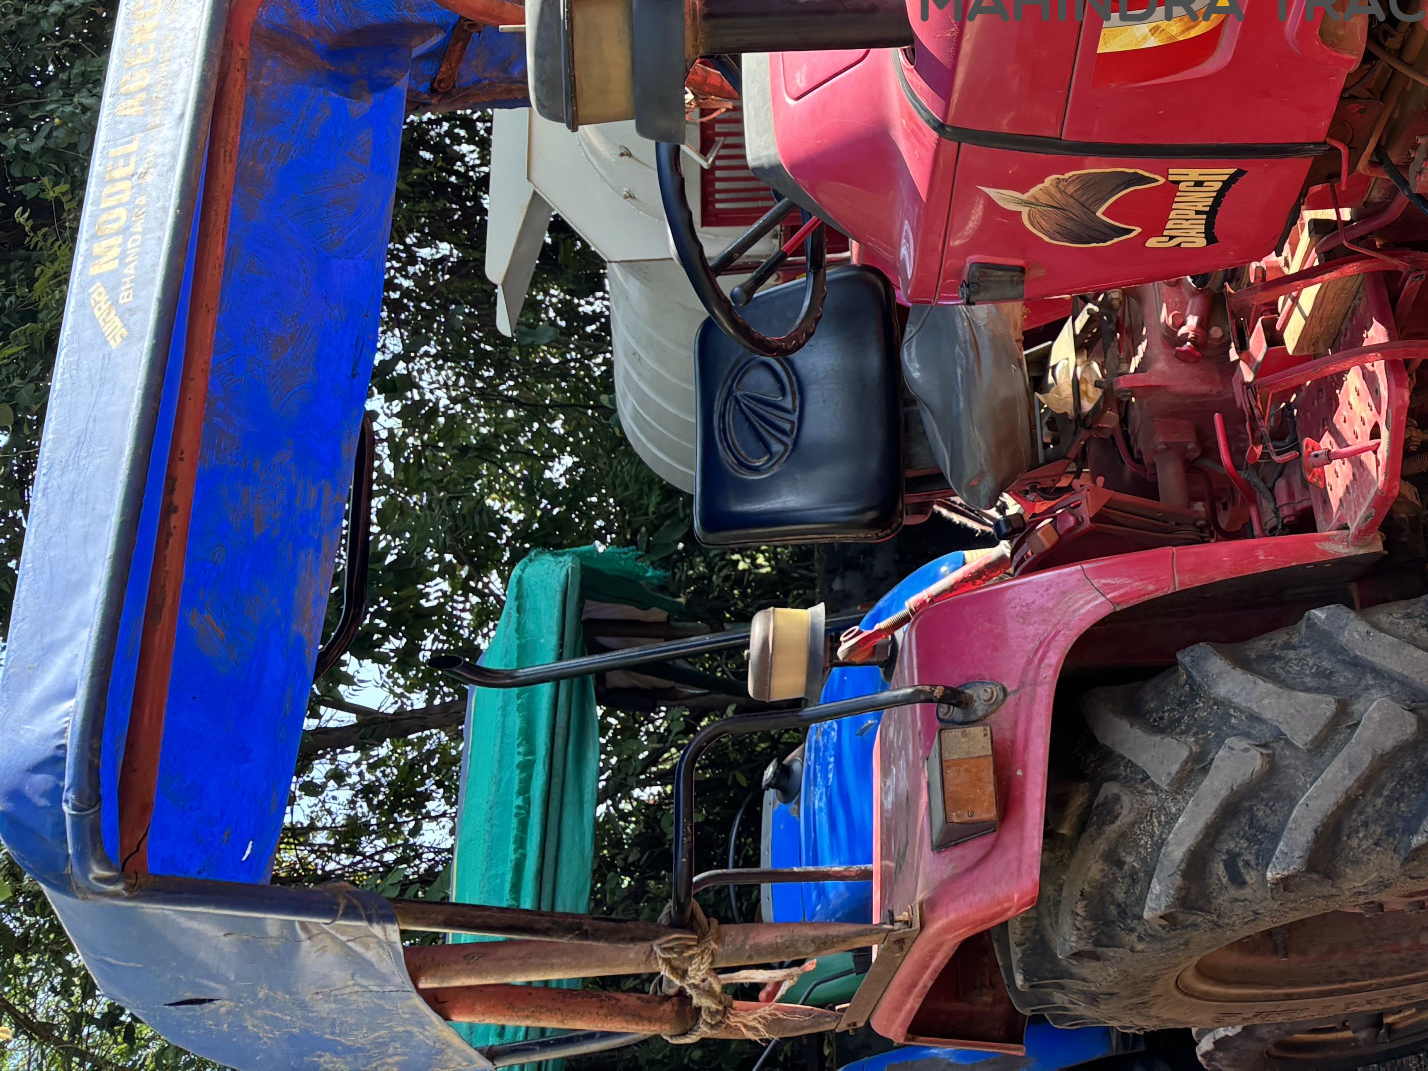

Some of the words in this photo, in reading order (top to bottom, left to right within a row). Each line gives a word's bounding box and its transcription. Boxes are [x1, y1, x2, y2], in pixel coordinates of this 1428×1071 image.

[88, 135, 141, 276] MODEL
[118, 195, 147, 304] BHANDARA
[1144, 167, 1238, 249] SARPANCH
